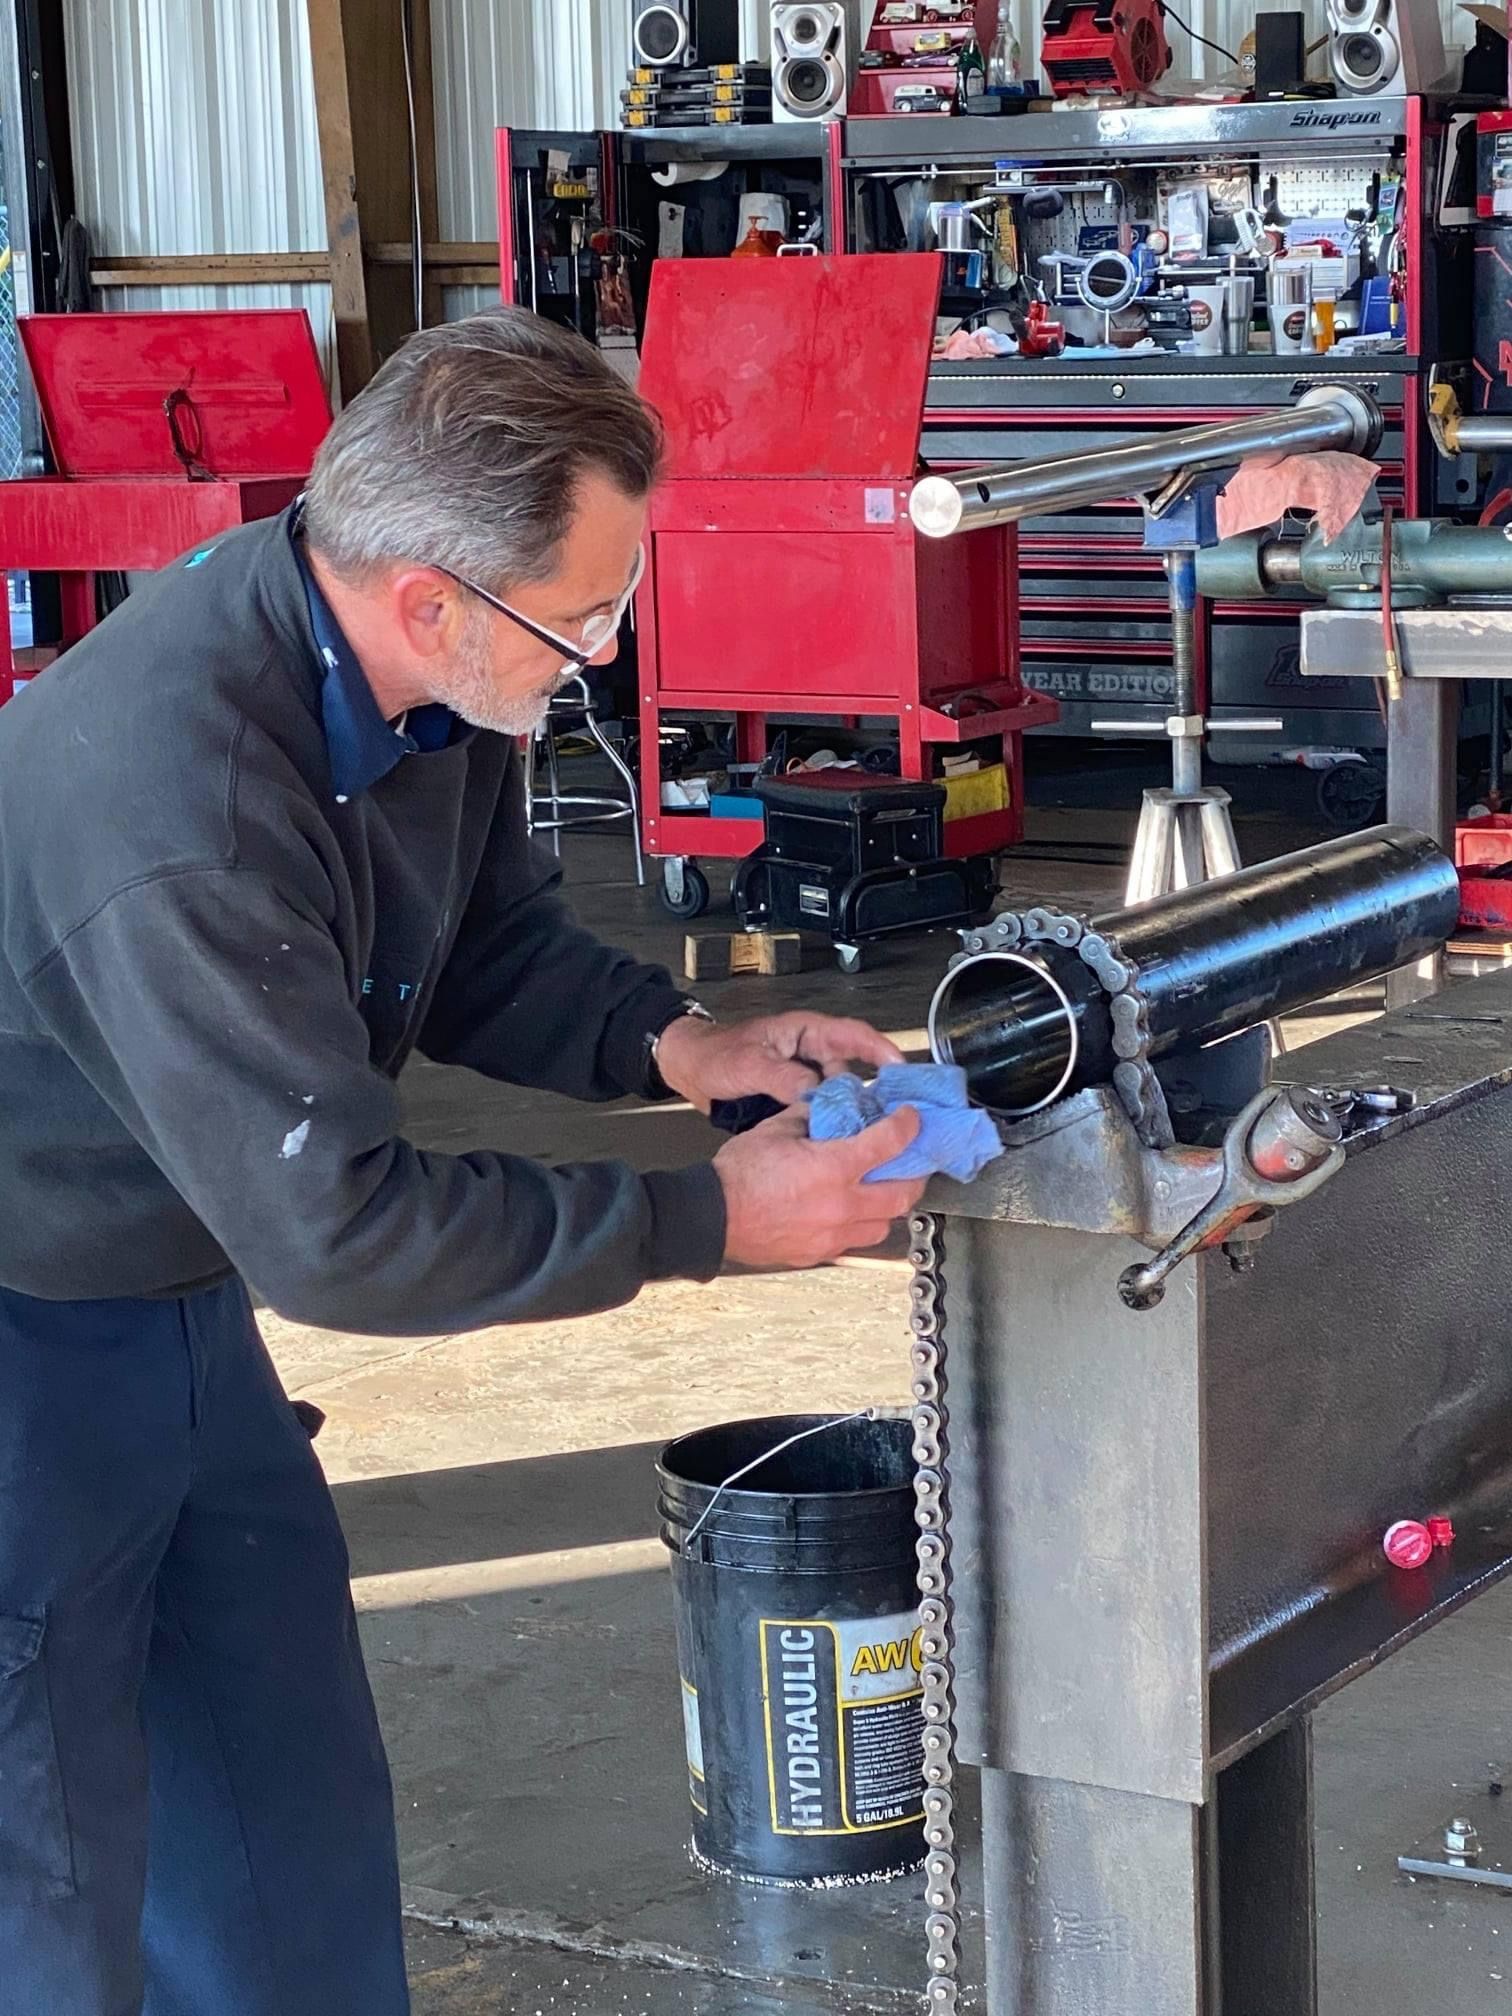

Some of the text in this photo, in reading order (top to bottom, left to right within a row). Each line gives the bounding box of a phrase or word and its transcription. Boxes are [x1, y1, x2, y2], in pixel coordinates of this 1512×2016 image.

[1020, 671, 1175, 696] YEAR EDITIO
[780, 1628, 824, 1827] HYDRAULIC
[856, 1813, 862, 1824] 5
